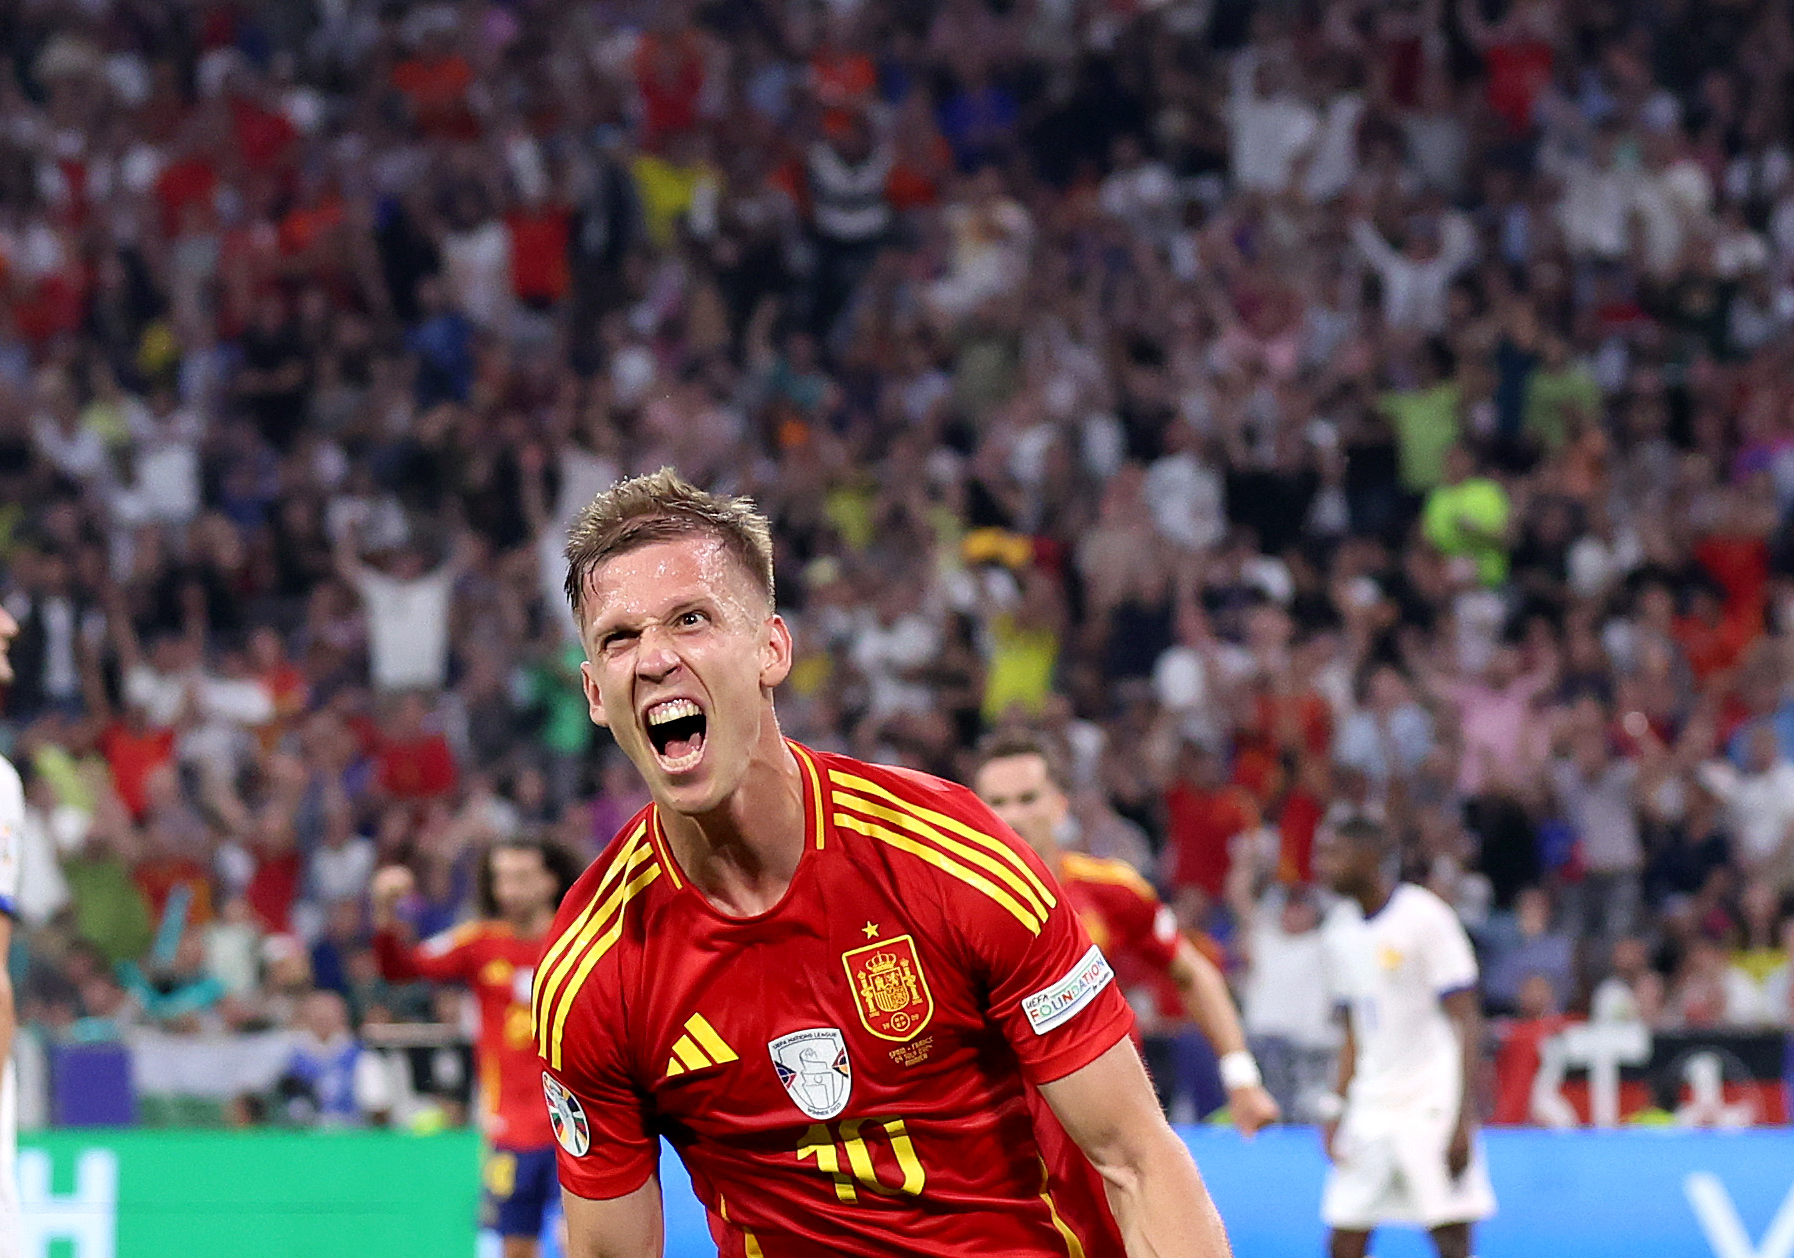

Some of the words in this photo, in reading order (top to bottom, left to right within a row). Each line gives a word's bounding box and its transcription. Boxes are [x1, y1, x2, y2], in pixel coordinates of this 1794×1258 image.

[1026, 994, 1049, 1009] UEFA
[1030, 957, 1105, 1022] FOUNDATION
[796, 1114, 926, 1204] 10
